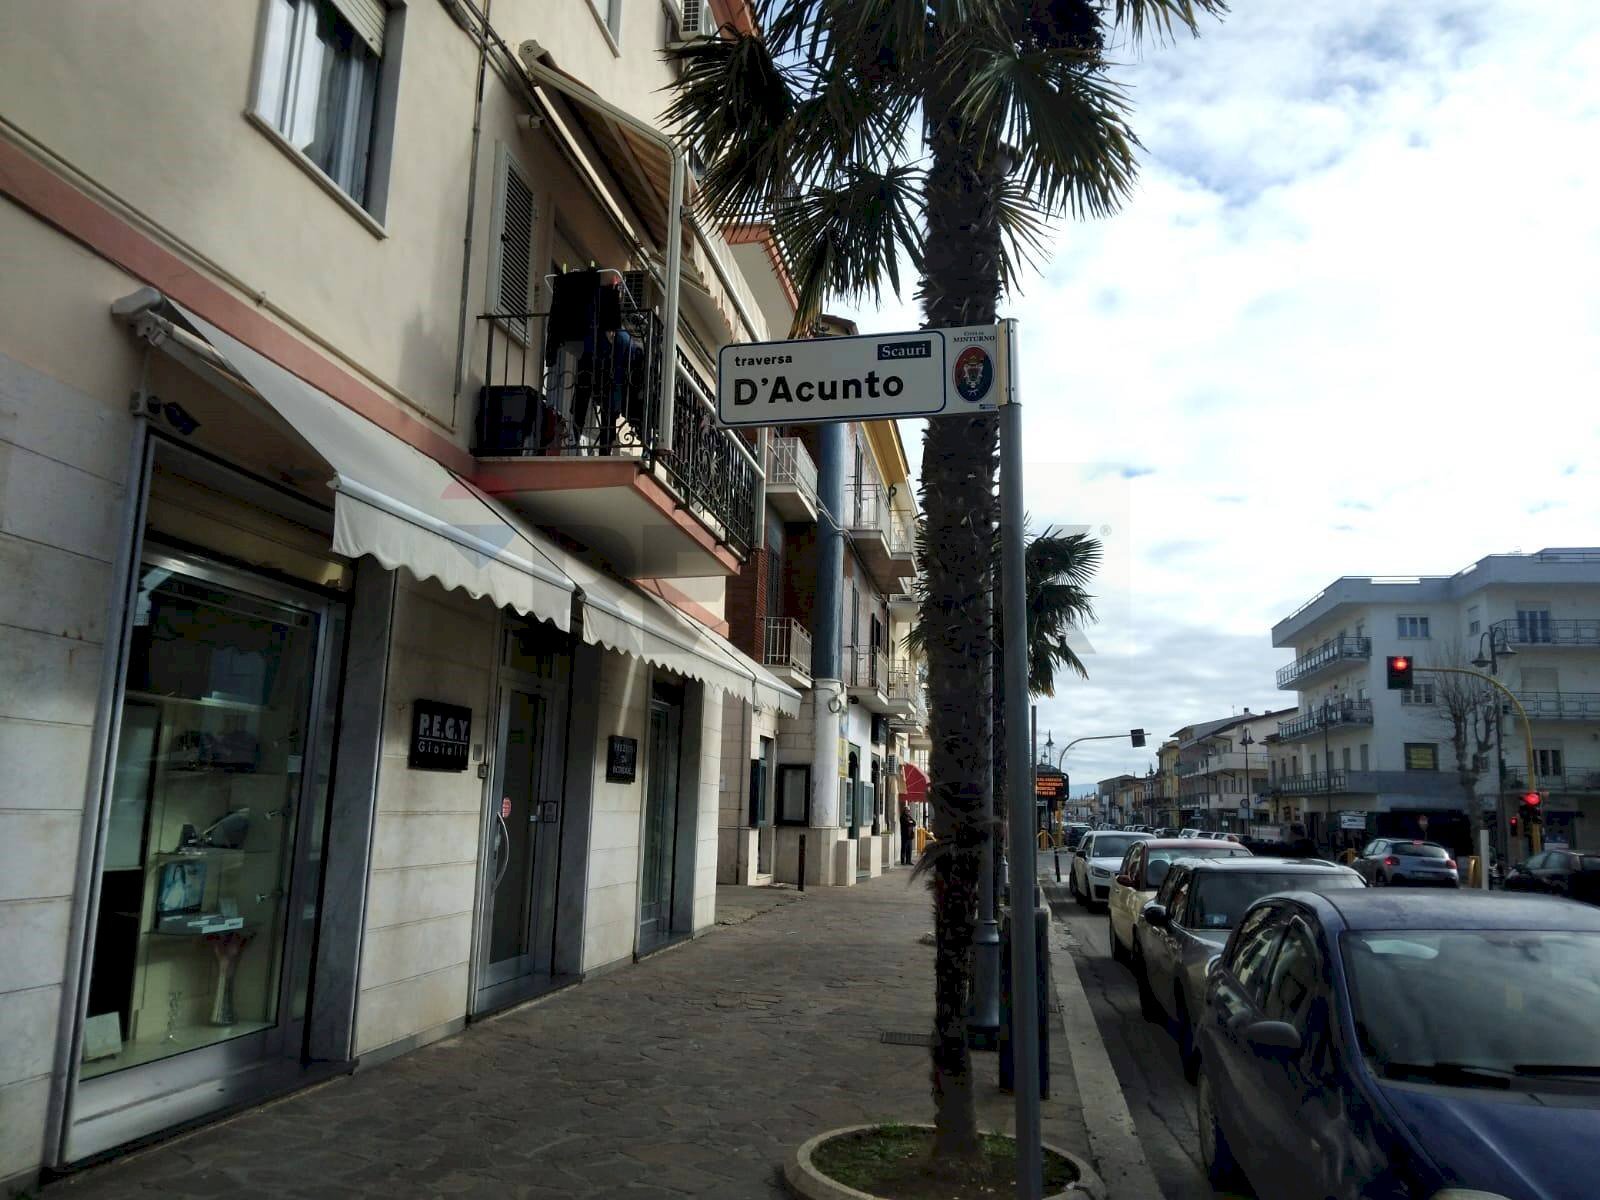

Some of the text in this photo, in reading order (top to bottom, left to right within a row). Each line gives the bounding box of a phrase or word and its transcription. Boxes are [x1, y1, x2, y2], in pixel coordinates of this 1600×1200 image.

[880, 343, 927, 359] Scauri
[734, 354, 793, 367] traversa
[734, 371, 904, 405] D'Acunto
[418, 740, 469, 759] Gioielli
